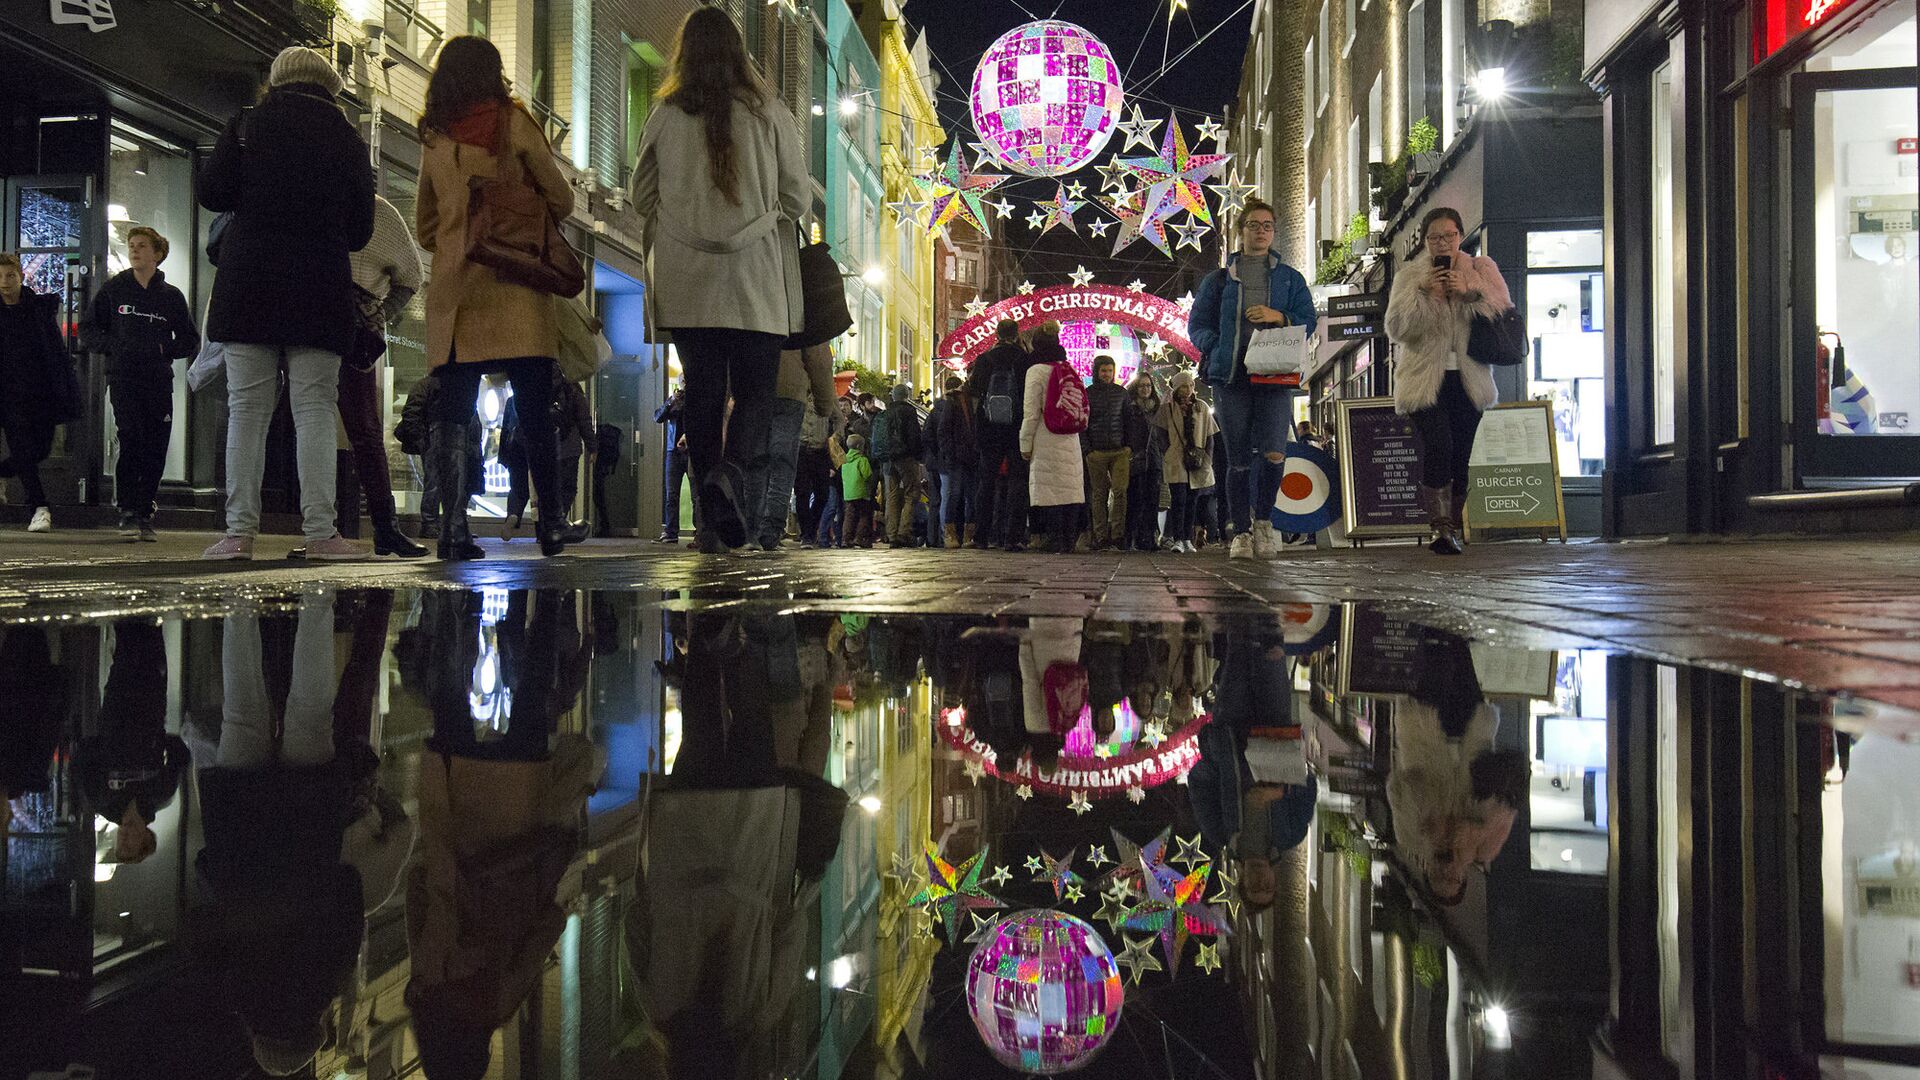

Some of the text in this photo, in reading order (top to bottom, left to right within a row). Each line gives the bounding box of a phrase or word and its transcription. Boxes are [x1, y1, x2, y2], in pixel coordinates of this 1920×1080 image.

[1039, 292, 1158, 322] CHRISTMAS
[1336, 300, 1379, 310] DIESEL
[118, 304, 168, 323] Champion
[1343, 325, 1373, 336] MALE
[385, 333, 401, 345] ecret
[1476, 475, 1542, 488] BURGER Co
[1489, 499, 1519, 509] OPEN
